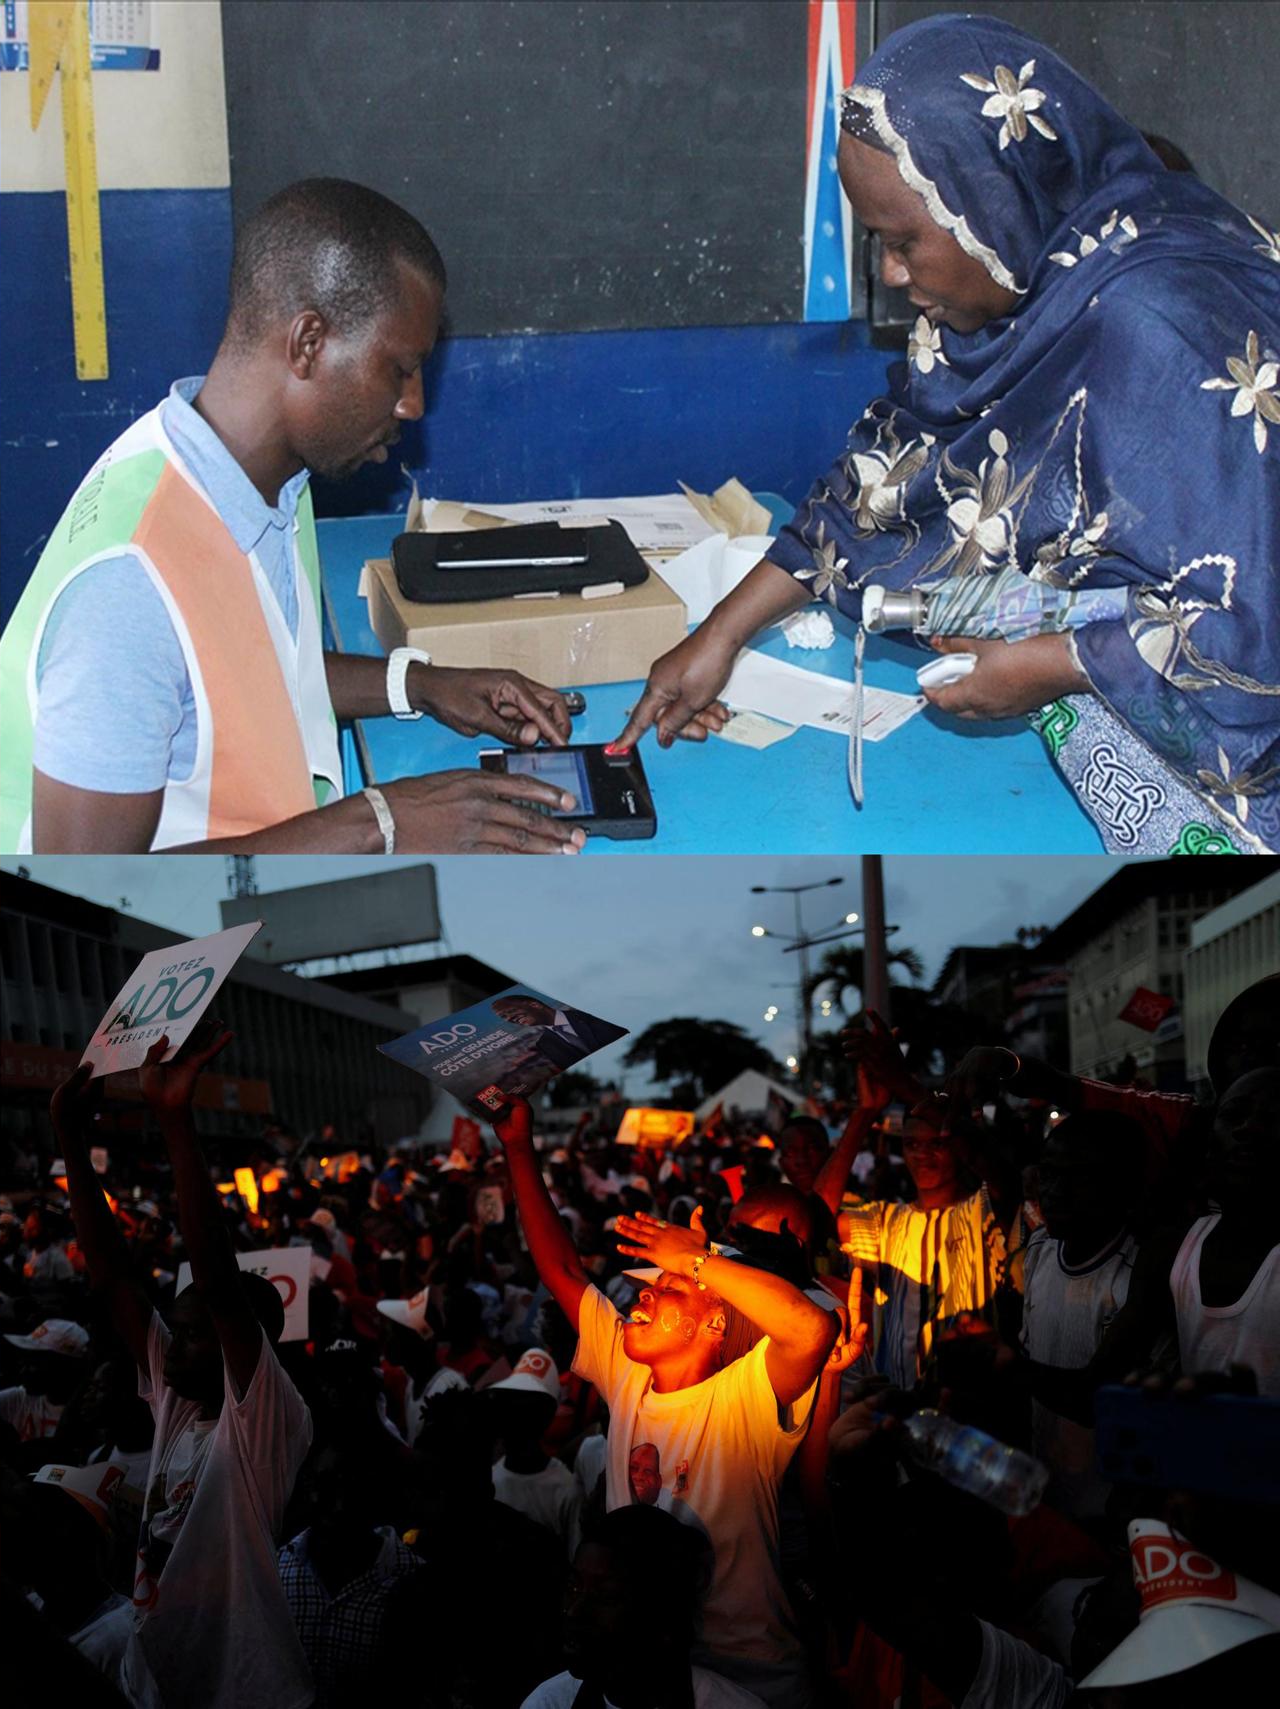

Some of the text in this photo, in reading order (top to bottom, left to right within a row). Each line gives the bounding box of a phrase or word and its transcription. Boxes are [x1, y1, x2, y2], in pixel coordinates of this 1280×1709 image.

[158, 956, 206, 978] VOTEZ
[102, 966, 215, 1036] ADO
[419, 1023, 477, 1055] ADO
[461, 1029, 508, 1053] GRANDE
[470, 1033, 518, 1059] D'IVOIRE
[1132, 1545, 1222, 1584] ADO
